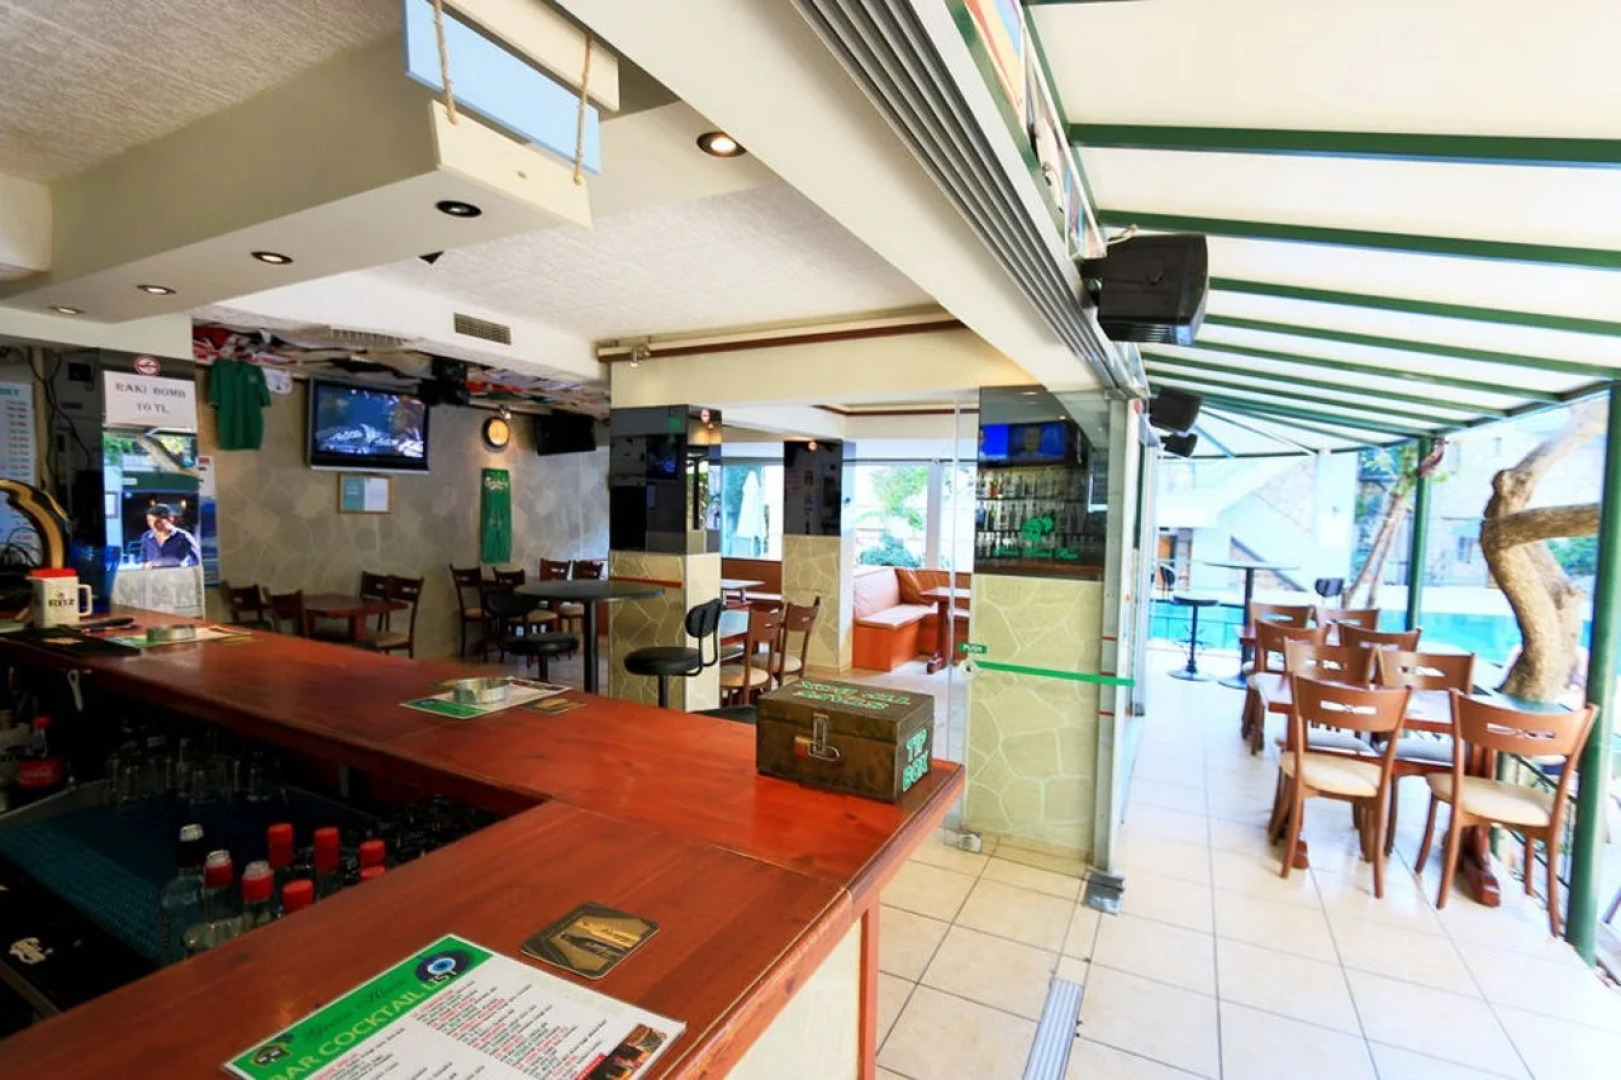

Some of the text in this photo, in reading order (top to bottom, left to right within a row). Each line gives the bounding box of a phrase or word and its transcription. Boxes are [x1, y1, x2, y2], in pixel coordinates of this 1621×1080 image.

[153, 386, 186, 399] BOMB
[906, 728, 927, 762] TIP
[902, 749, 928, 793] BOX
[318, 991, 426, 1056] COCKTAIL
[420, 970, 458, 991] LIST
